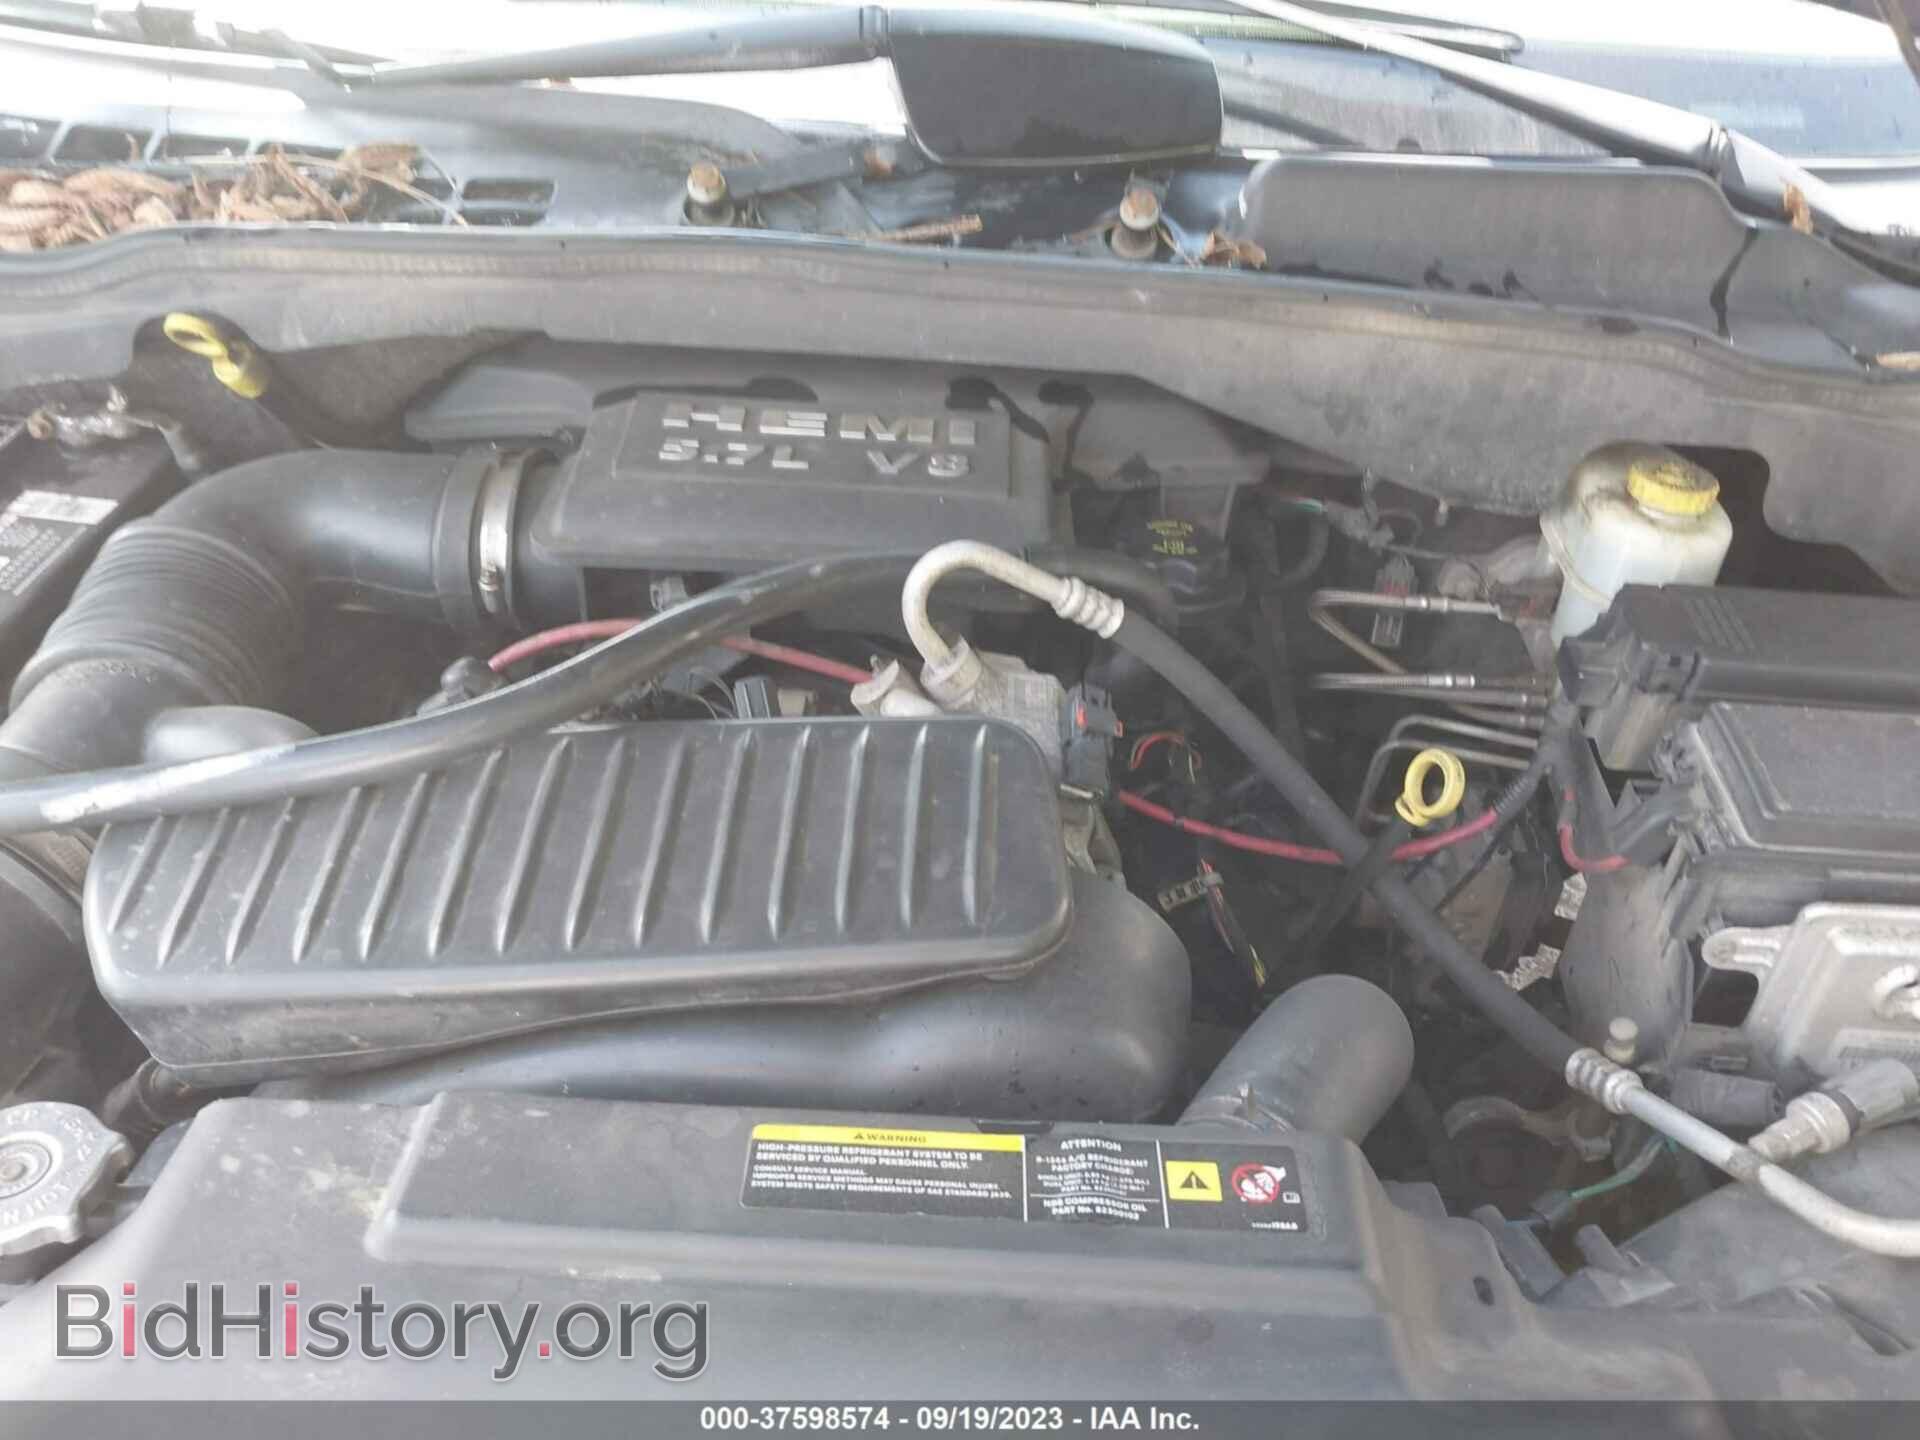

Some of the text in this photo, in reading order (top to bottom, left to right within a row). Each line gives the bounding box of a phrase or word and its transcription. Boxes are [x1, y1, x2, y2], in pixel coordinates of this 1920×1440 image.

[663, 403, 975, 446] HEMI
[659, 438, 971, 477] 5.7L V8
[867, 1133, 927, 1143] WARNING
[1061, 1138, 1122, 1152] ATTENTION
[756, 1152, 806, 1161] SERVICED
[808, 1153, 821, 1162] BY
[822, 1155, 877, 1165] QUALIFIED
[879, 1157, 938, 1168] PERSONNEL
[758, 1143, 983, 1161] HIGH-PRESSURE REFRIGERANT SYSTEM TO BE
